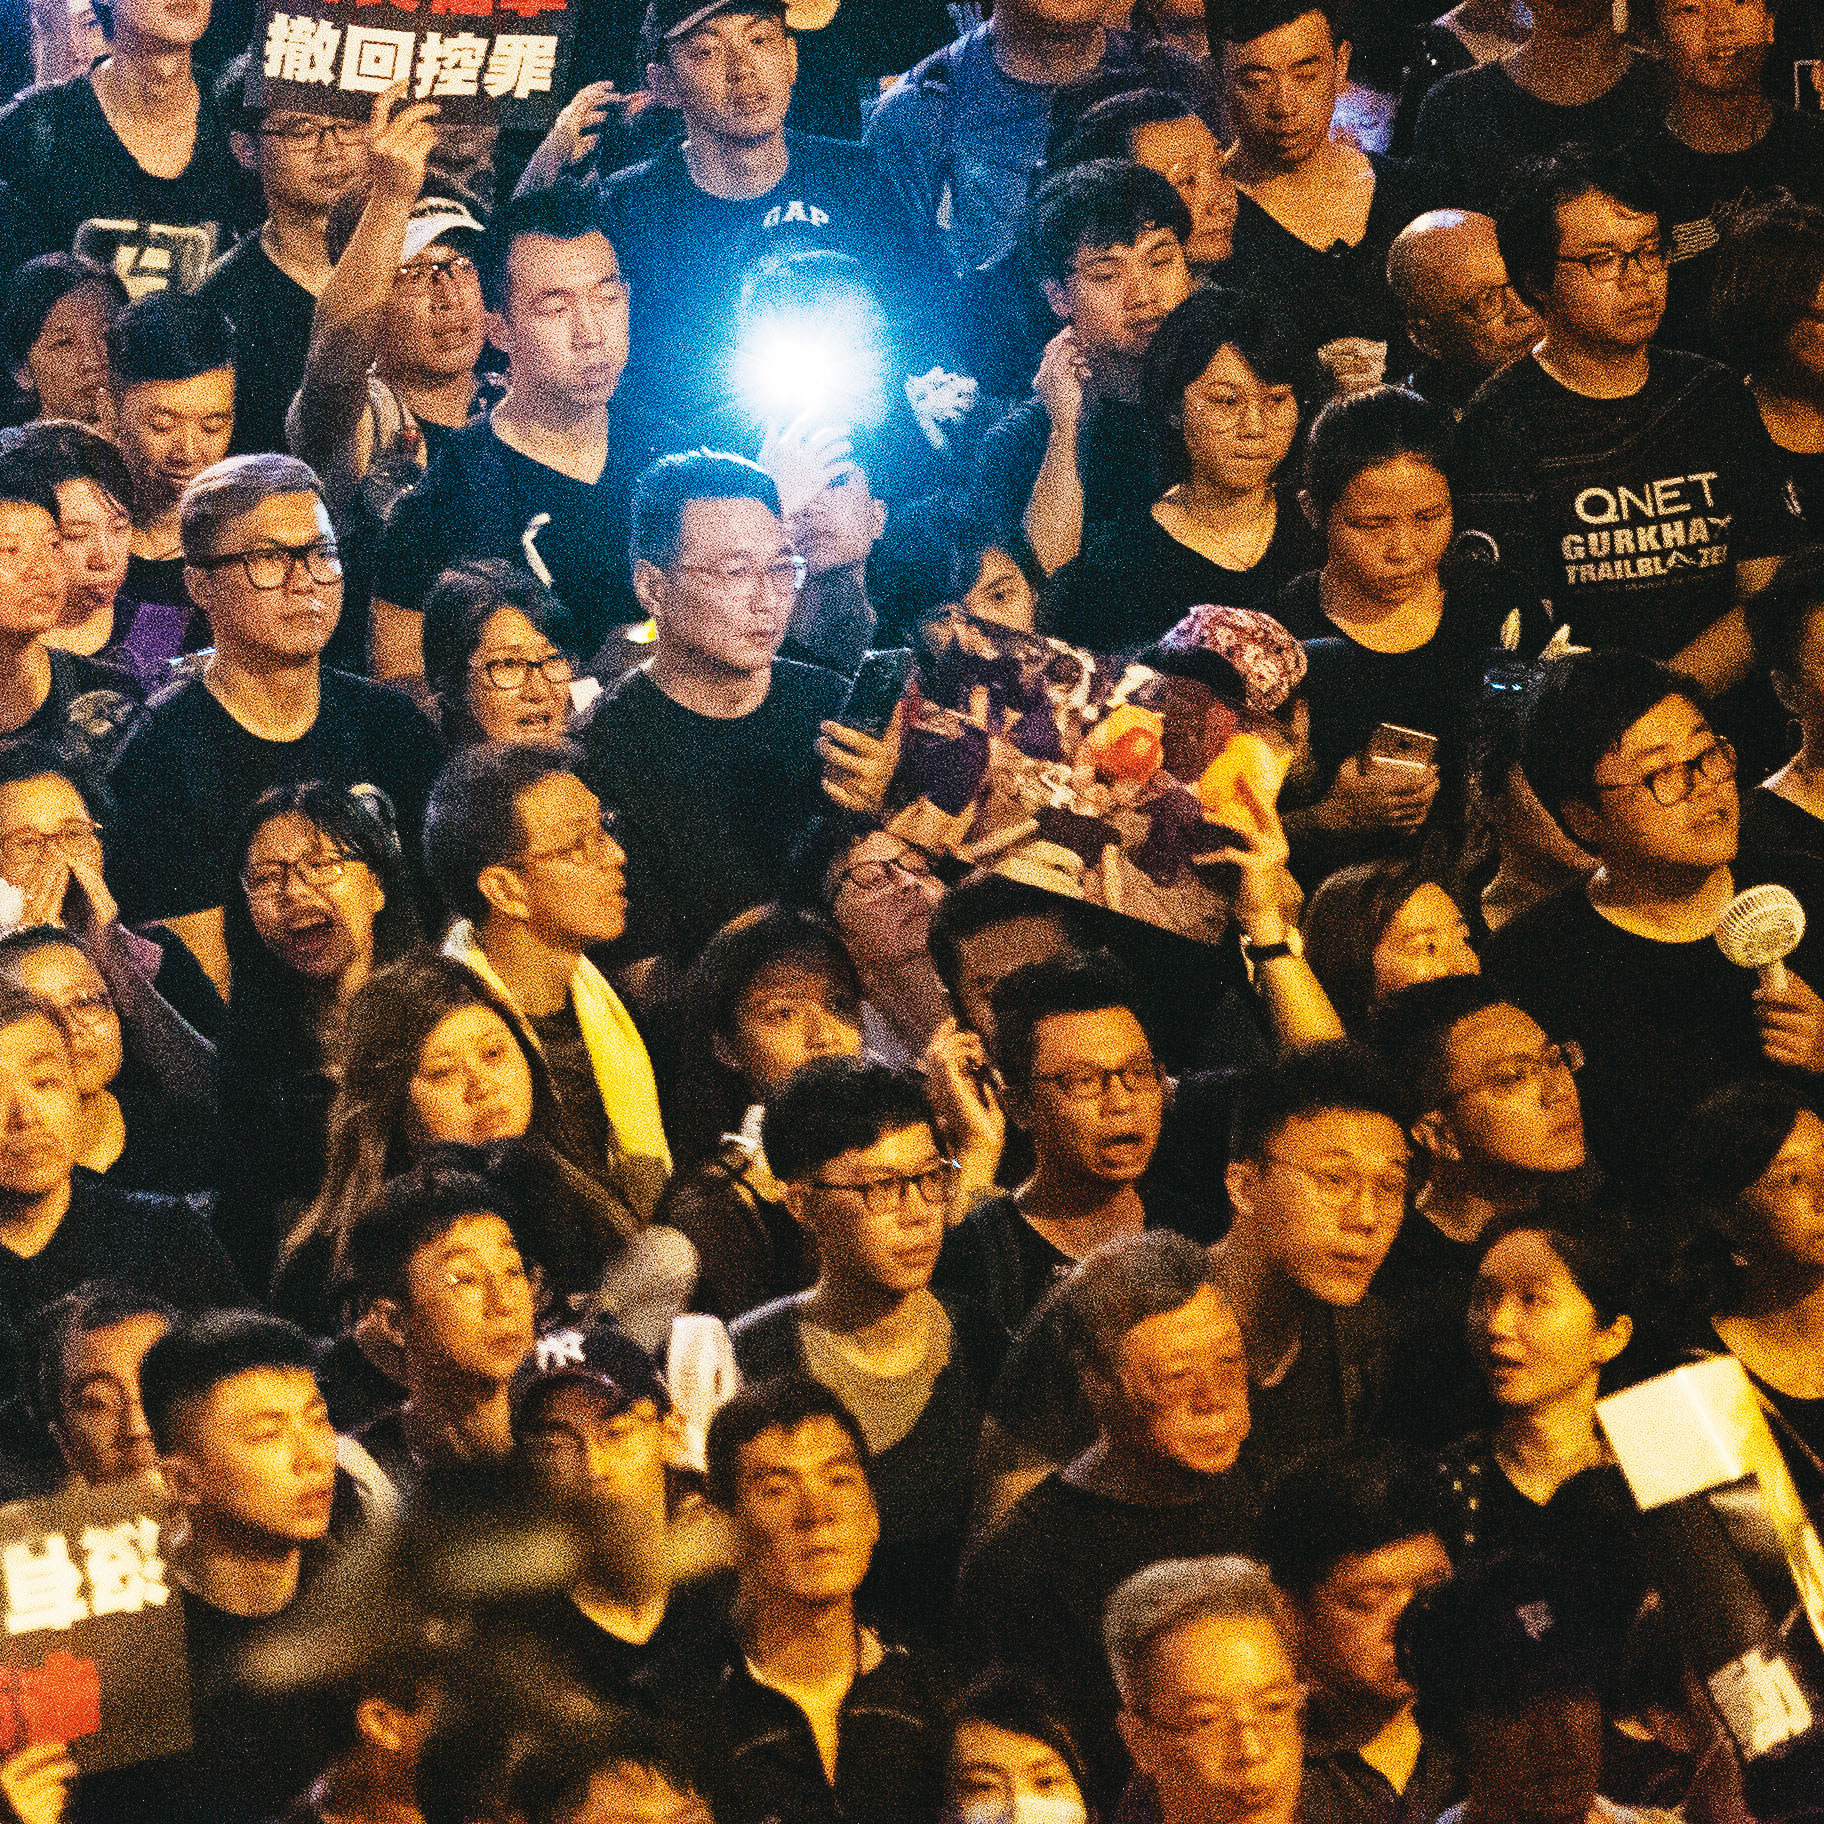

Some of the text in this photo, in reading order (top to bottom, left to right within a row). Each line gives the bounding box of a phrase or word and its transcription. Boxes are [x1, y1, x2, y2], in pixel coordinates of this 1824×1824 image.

[263, 14, 558, 99] 撤回控罪
[1574, 472, 1718, 525] QNET
